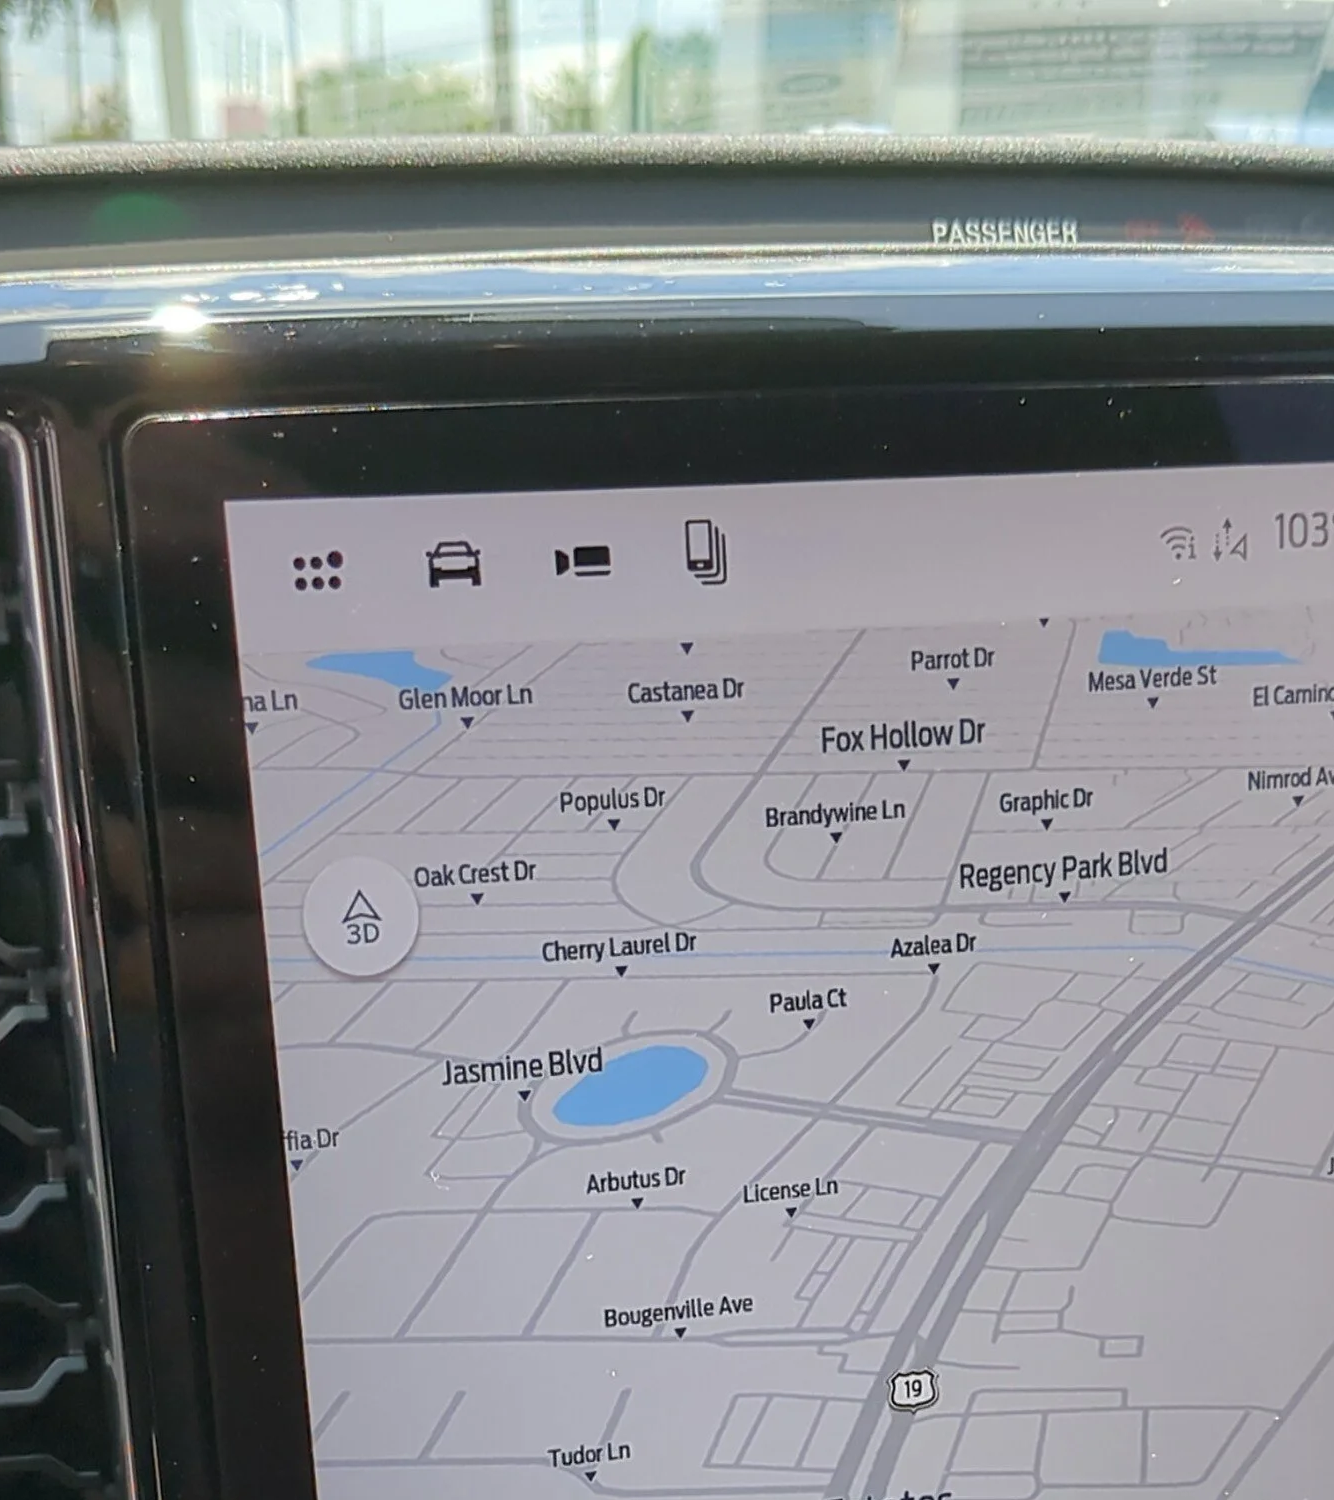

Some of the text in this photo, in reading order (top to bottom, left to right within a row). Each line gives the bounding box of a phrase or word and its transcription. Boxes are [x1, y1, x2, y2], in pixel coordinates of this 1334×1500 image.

[931, 219, 1078, 245] PASSENGER
[911, 647, 995, 671] Parrot Dr
[628, 678, 744, 704] Castanea Dr
[1088, 665, 1217, 692] Mesa Verde St
[271, 690, 298, 711] Ln
[399, 684, 532, 710] Glen Moor Ln
[1253, 687, 1268, 707] El
[821, 719, 985, 754] Fox Hollow Dr
[1248, 769, 1310, 790] Nimrod
[560, 787, 666, 816] Populus Dr
[1000, 788, 1093, 817] Graphic Dr
[766, 800, 906, 831] Brandywine Ln
[415, 861, 536, 888] Oak Crest Dr
[960, 849, 1167, 892] Regency Park Blvd
[346, 923, 380, 945] 3D
[891, 933, 976, 957] Azalea Dr
[542, 932, 696, 966] Cherry Laurel Dr
[770, 988, 847, 1013] Paula Ct
[442, 1048, 603, 1086] Jasmine Blvd
[283, 1128, 339, 1151] fia Dr
[587, 1167, 686, 1194] Arbutus Dr
[743, 1177, 839, 1203] License Ln
[604, 1294, 753, 1330] Bougenville Ave
[904, 1379, 922, 1400] 19
[548, 1441, 631, 1468] Tudor Ln
